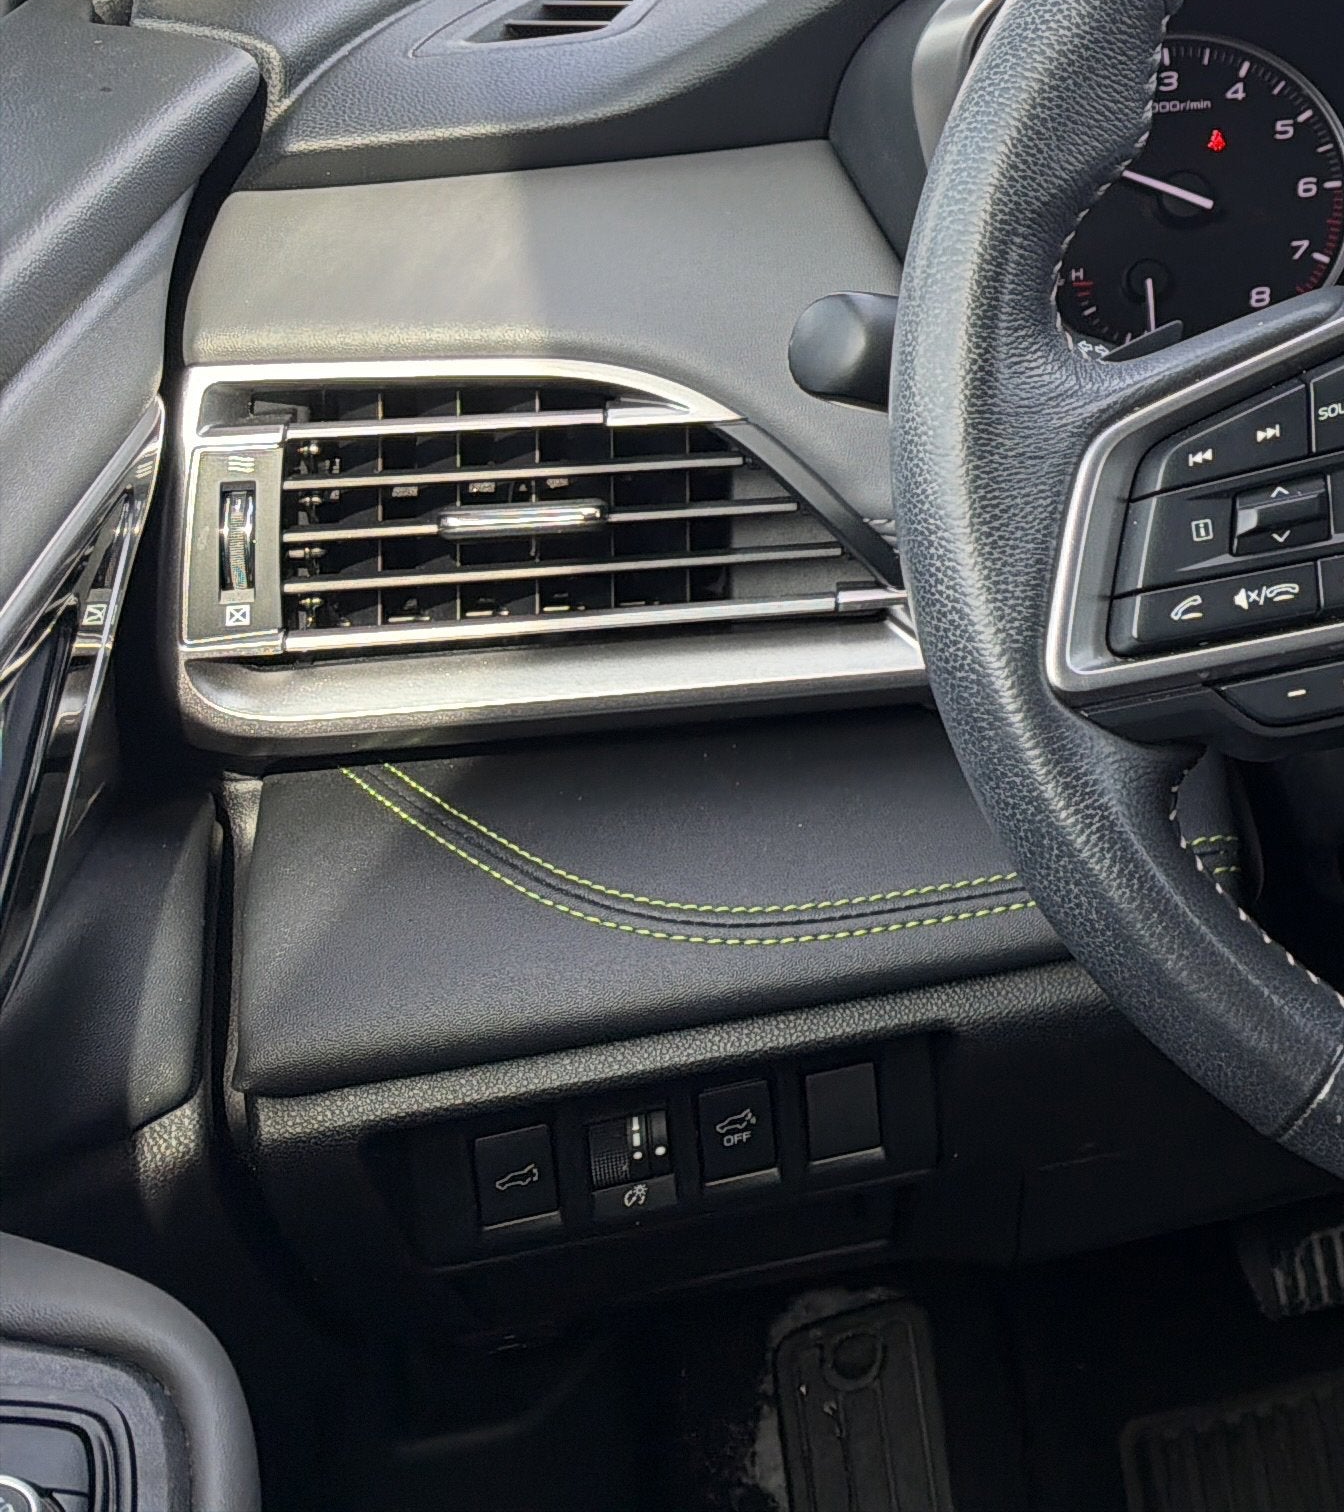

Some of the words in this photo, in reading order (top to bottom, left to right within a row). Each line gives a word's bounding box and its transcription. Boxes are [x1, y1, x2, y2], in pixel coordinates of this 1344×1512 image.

[1158, 70, 1179, 92] 3
[1225, 81, 1247, 102] 4
[1274, 119, 1295, 140] 5
[1296, 176, 1318, 198] 6
[1290, 239, 1311, 260] 7
[1071, 268, 1085, 281] H
[1249, 285, 1271, 308] 8
[722, 1130, 752, 1148] OFF
